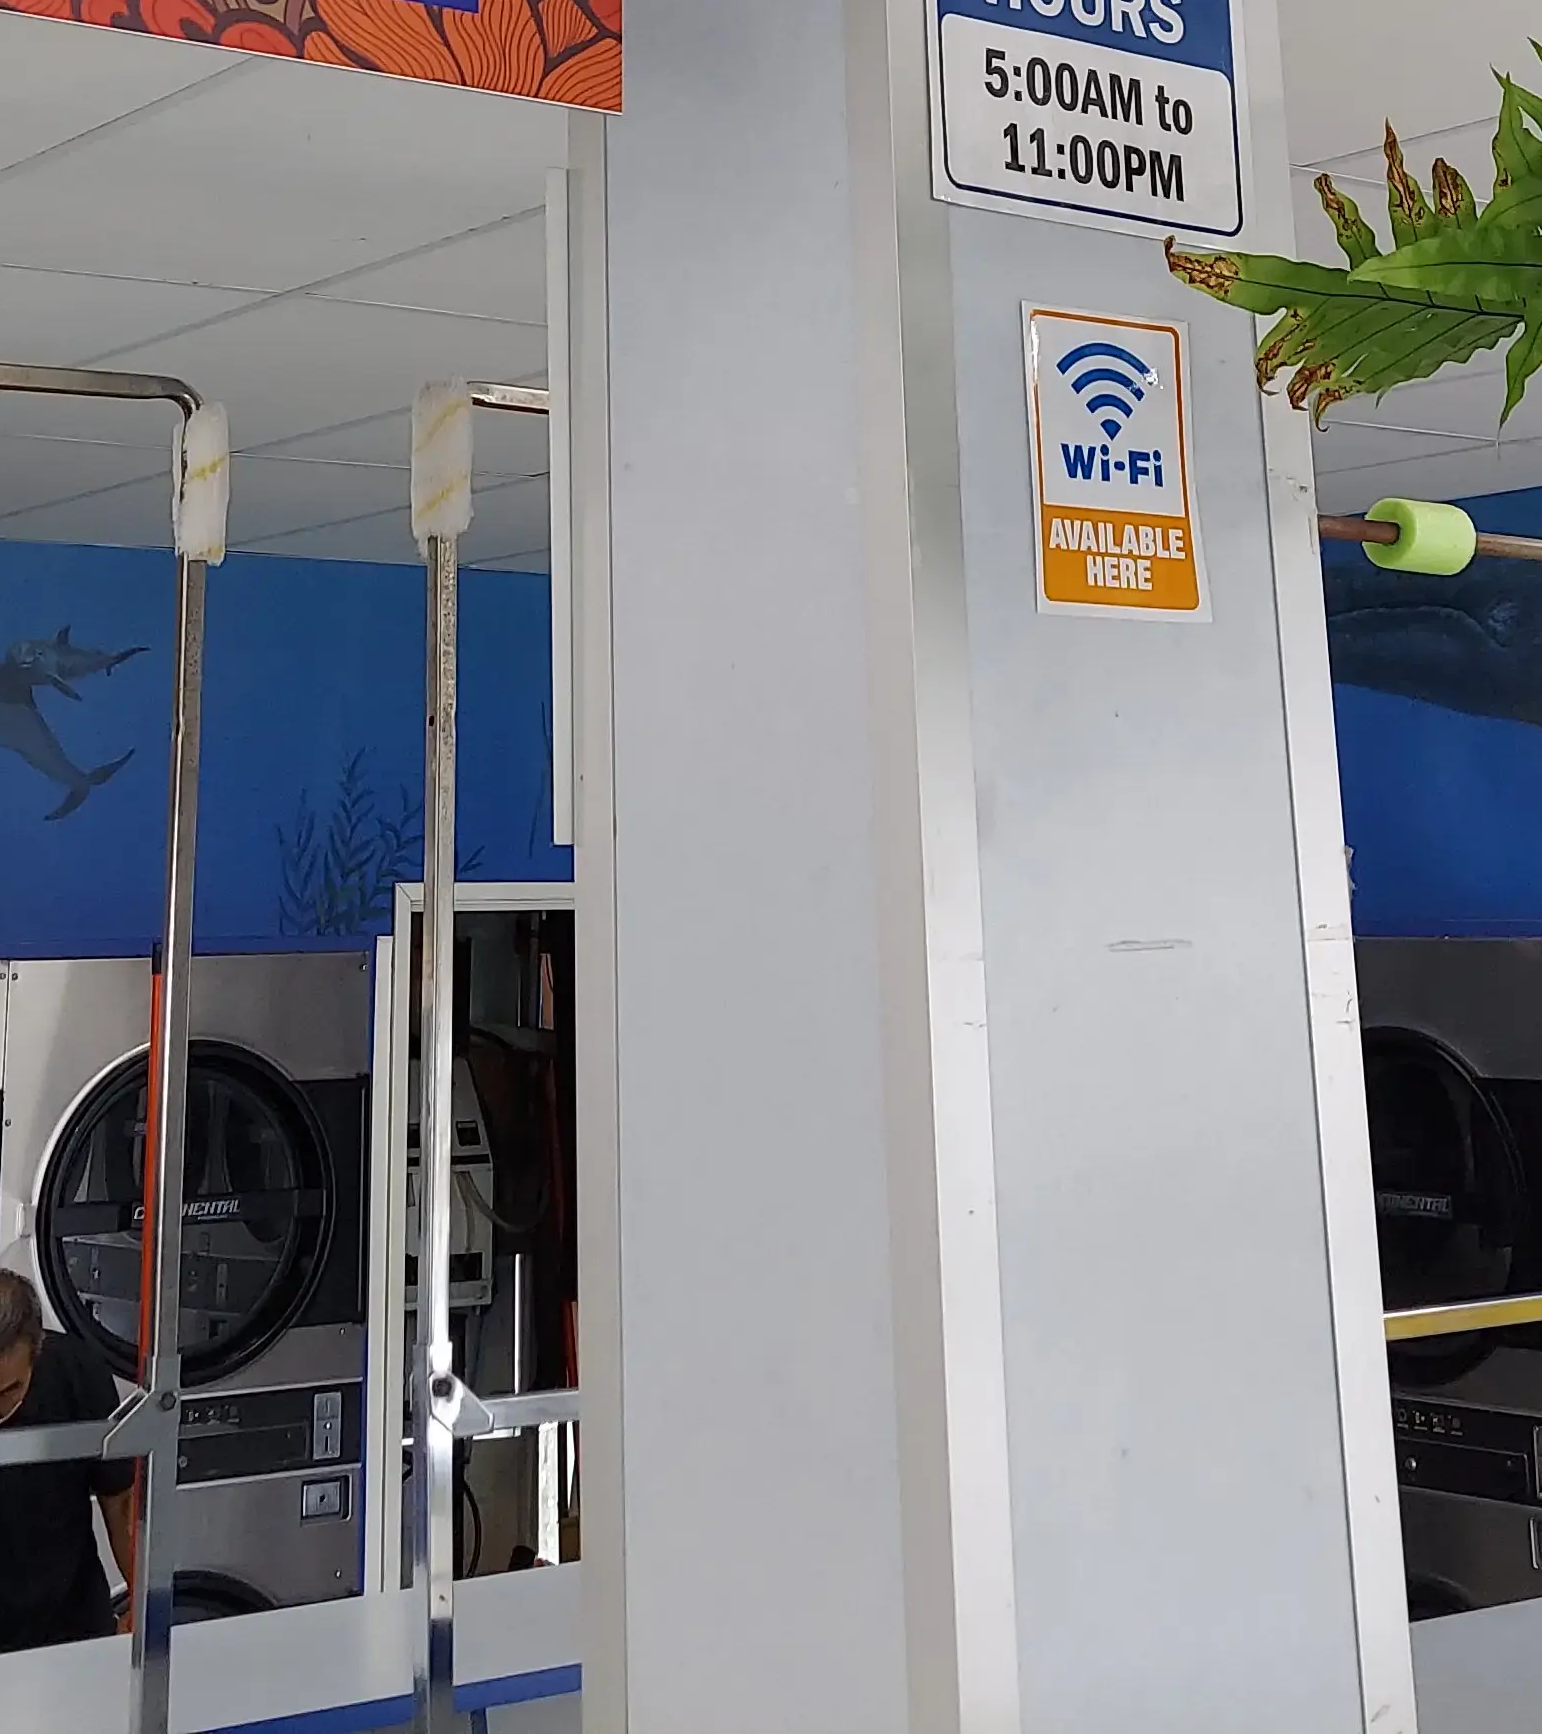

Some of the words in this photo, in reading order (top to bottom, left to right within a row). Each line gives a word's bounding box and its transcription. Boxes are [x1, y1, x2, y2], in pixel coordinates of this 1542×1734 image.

[984, 48, 1144, 126] 5:00AM
[1155, 85, 1193, 134] to
[1003, 123, 1185, 202] 11:00PM
[1060, 443, 1163, 487] Wi-Fi
[1049, 518, 1186, 559] AVAILABLE
[1086, 555, 1153, 590] HERE
